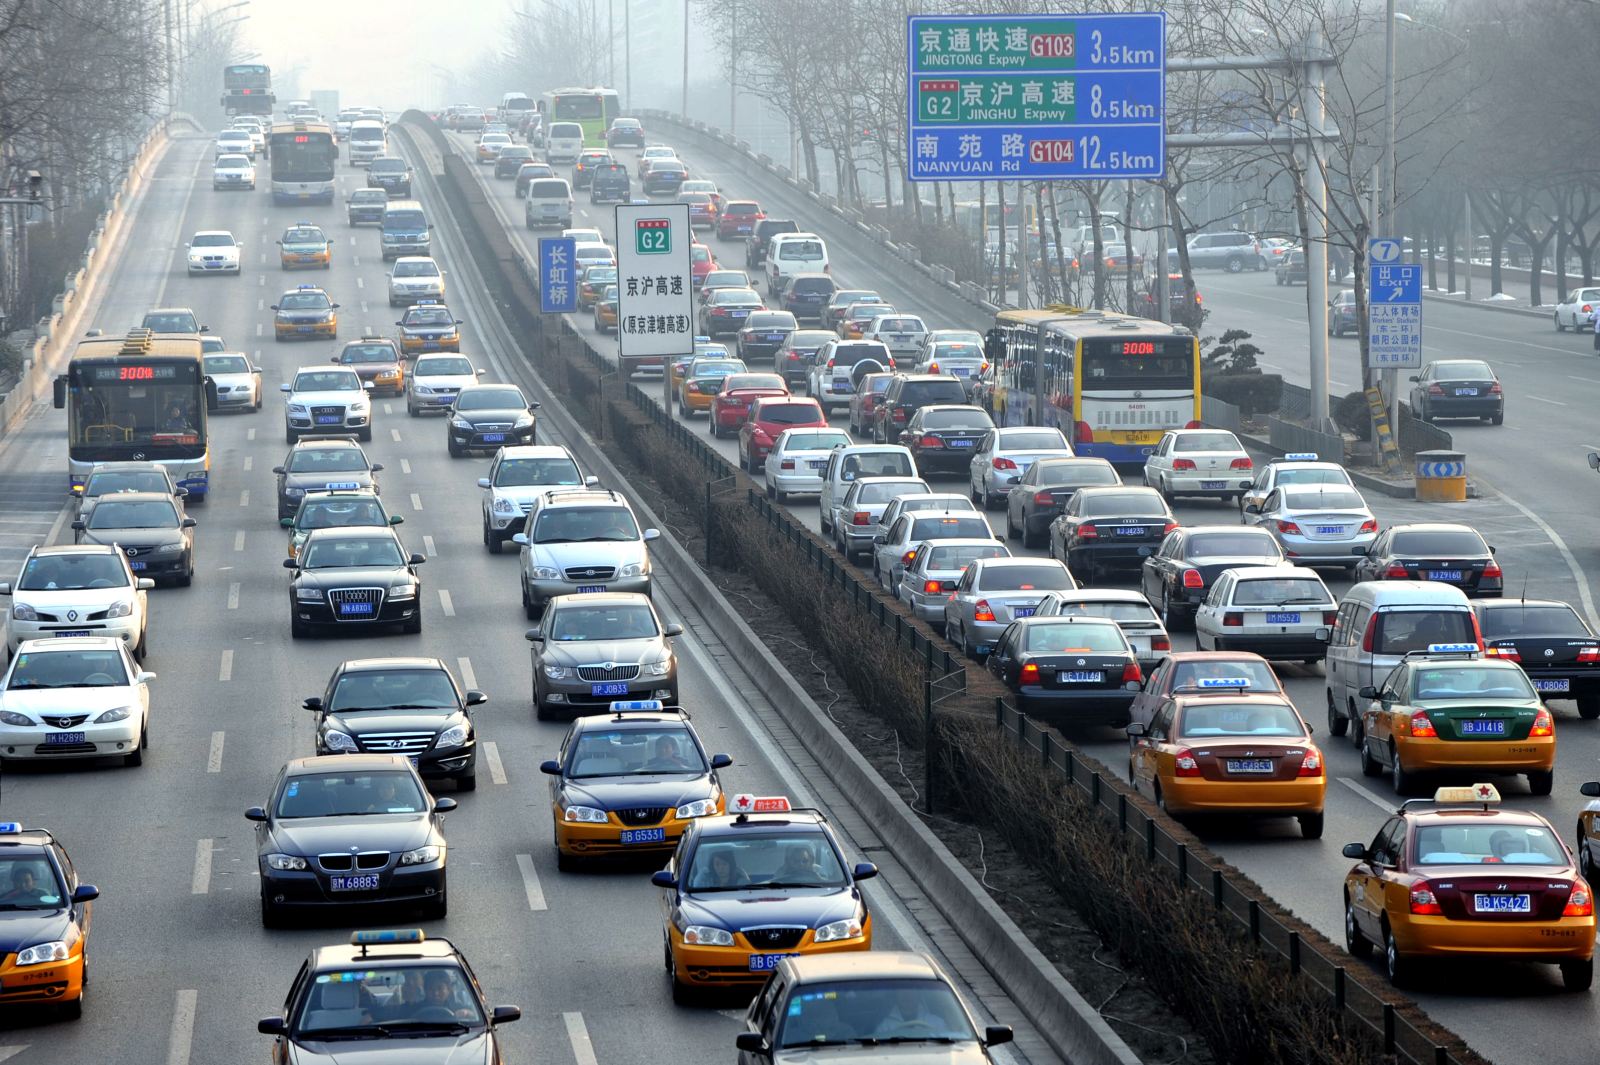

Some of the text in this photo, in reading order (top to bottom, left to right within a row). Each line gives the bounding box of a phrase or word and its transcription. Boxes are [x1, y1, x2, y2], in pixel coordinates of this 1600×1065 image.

[919, 27, 1028, 52] 京通快速
[1031, 36, 1073, 56] G103
[922, 54, 1026, 67] JINGTONG Expwy
[961, 81, 1075, 106] 京沪高速
[967, 108, 1066, 121] JINGHU Expwy
[1031, 142, 1073, 162] G104
[917, 160, 1020, 173] NANYUAN Rd
[642, 231, 665, 249] G2
[1380, 243, 1392, 260] 7
[549, 246, 569, 305] 长虹桥
[1379, 266, 1413, 280] 出口
[626, 275, 683, 297] 京沪高速
[1371, 306, 1419, 317] 工人体育场
[622, 314, 690, 335] (原京津塘高速)
[1371, 334, 1420, 345] 朝阳公园桥
